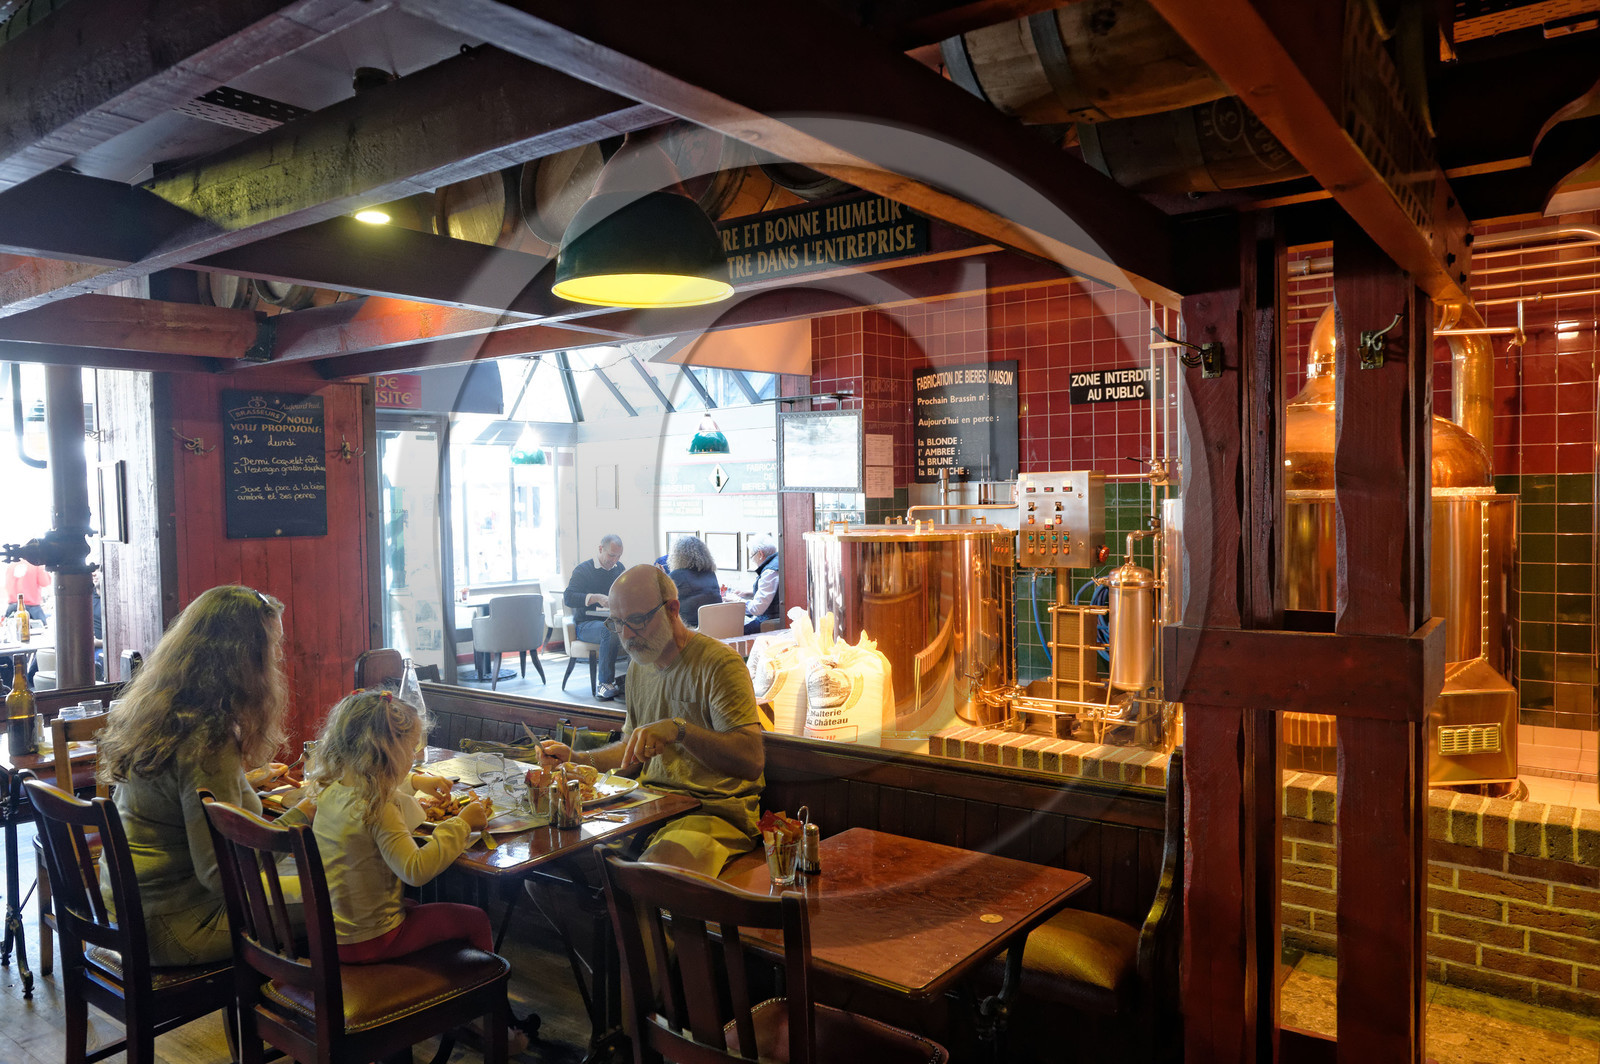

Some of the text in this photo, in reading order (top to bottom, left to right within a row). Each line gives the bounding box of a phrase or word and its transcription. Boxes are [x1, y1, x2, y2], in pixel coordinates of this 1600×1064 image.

[718, 197, 902, 252] RE ET BONNE HUMEUR
[727, 224, 916, 279] TRE DANS L'ENTREPRISE
[376, 376, 399, 389] DE
[916, 369, 1013, 391] FABRICATION DE BIERES MAISON
[1071, 373, 1101, 387] ZONE
[1087, 385, 1145, 401] AU PUBLIC
[917, 396, 948, 407] Prochain
[950, 394, 977, 404] Brassin
[235, 408, 281, 420] BRASSEURS
[287, 416, 313, 425] NOUS
[918, 416, 959, 428] Aujourd'hui
[973, 415, 994, 425] perce
[230, 423, 257, 432] VOUS
[918, 438, 925, 447] la
[926, 437, 958, 446] BLONDE
[925, 447, 956, 456] AMBREE
[918, 458, 925, 466] la
[927, 457, 953, 466] BRUNE
[918, 468, 925, 477] la
[927, 467, 965, 476] BLCHE
[814, 717, 849, 727] Château
